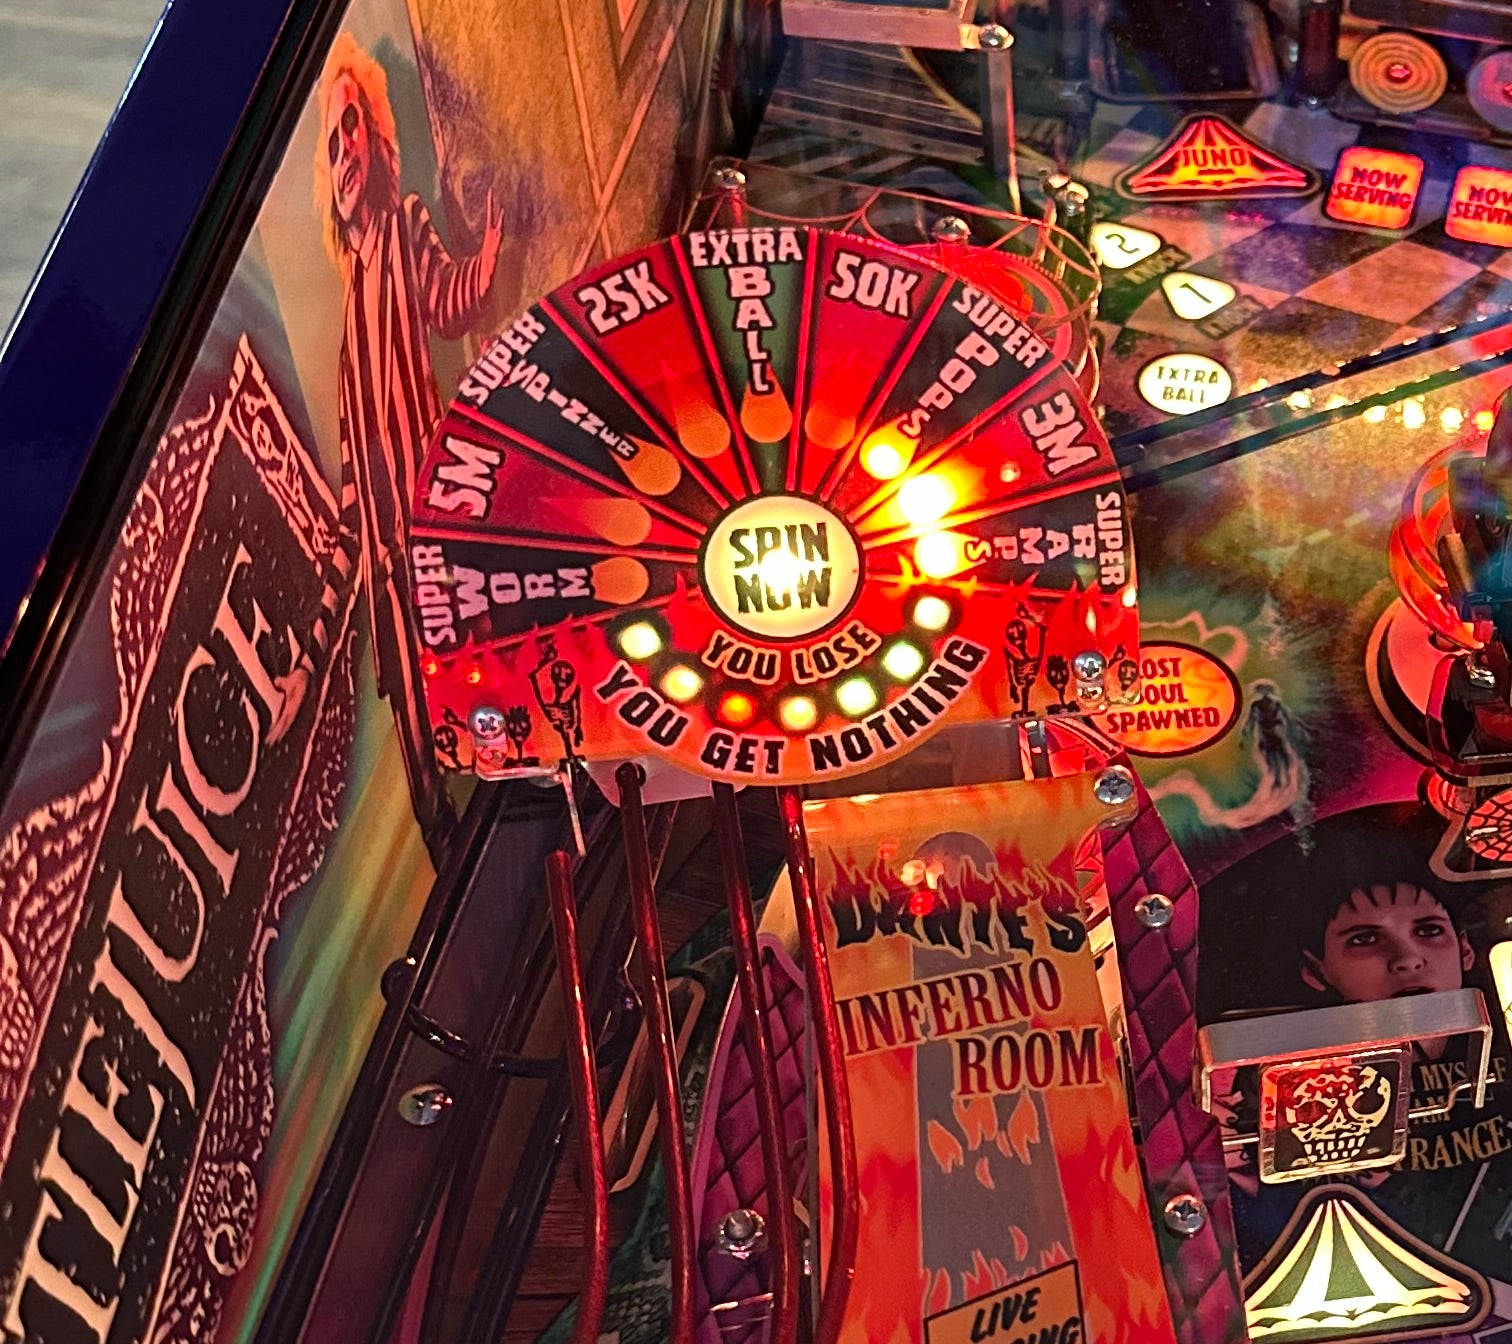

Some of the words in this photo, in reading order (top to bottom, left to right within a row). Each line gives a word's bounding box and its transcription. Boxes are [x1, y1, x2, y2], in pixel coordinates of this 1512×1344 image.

[1180, 147, 1249, 168] JUNO
[1350, 166, 1408, 188] NOW
[1332, 181, 1412, 209] SERVING
[690, 227, 803, 268] EXTRA
[576, 260, 669, 335] 25K
[729, 265, 773, 394] BALL
[951, 284, 1050, 369] SUPER
[457, 311, 547, 407] SUPER
[902, 330, 1000, 439] POPS
[504, 359, 637, 459] SPINNER
[1021, 391, 1098, 477] 3M
[729, 521, 830, 569] SPIN
[1094, 490, 1127, 587] SUPER
[412, 544, 457, 647] SUPER
[451, 564, 591, 621] WORM
[733, 566, 832, 614] NOW
[702, 631, 779, 683] YOU
[795, 623, 881, 684] LOSE
[1139, 657, 1182, 680] OST
[595, 662, 690, 748] YOU
[701, 732, 785, 774] GET
[809, 636, 989, 771] NOTHING
[1106, 707, 1221, 734] SPAWNED
[826, 851, 1090, 957] DANTE'S
[837, 958, 1064, 1056] INFERNO
[955, 1024, 1105, 1097] ROOM
[968, 1287, 1040, 1344] LIVE
